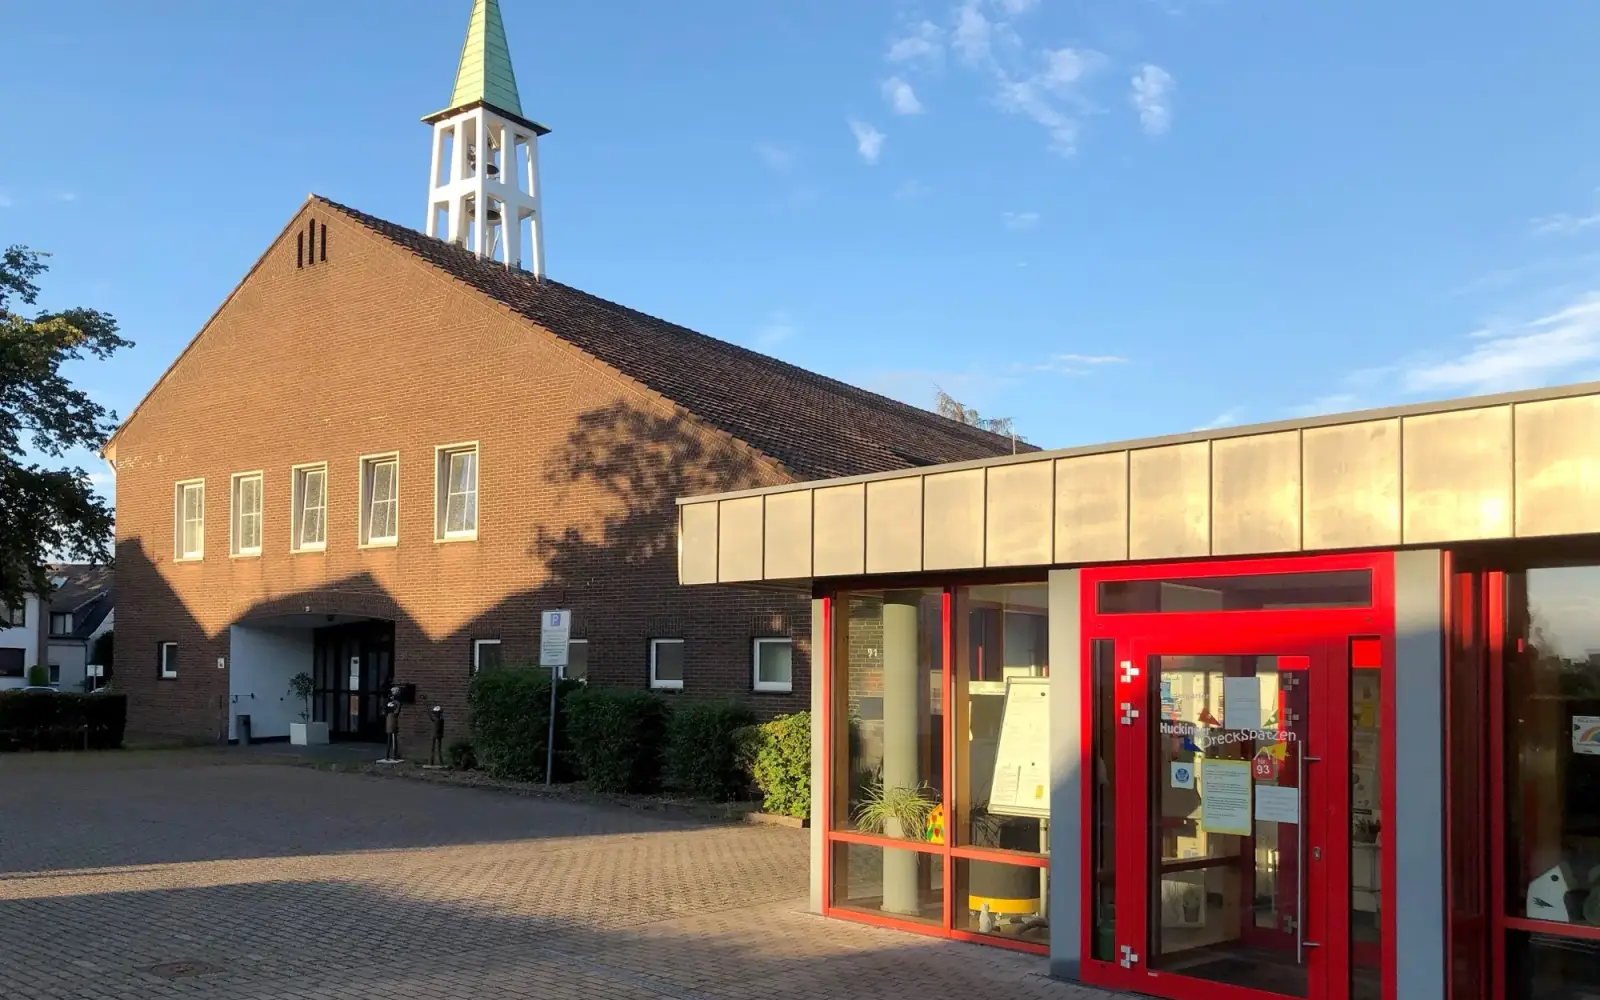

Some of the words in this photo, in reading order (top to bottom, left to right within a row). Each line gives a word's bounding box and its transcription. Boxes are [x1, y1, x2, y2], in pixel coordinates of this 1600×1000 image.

[552, 614, 559, 625] P
[1160, 722, 1210, 736] Huckinr
[1256, 764, 1270, 775] 93
